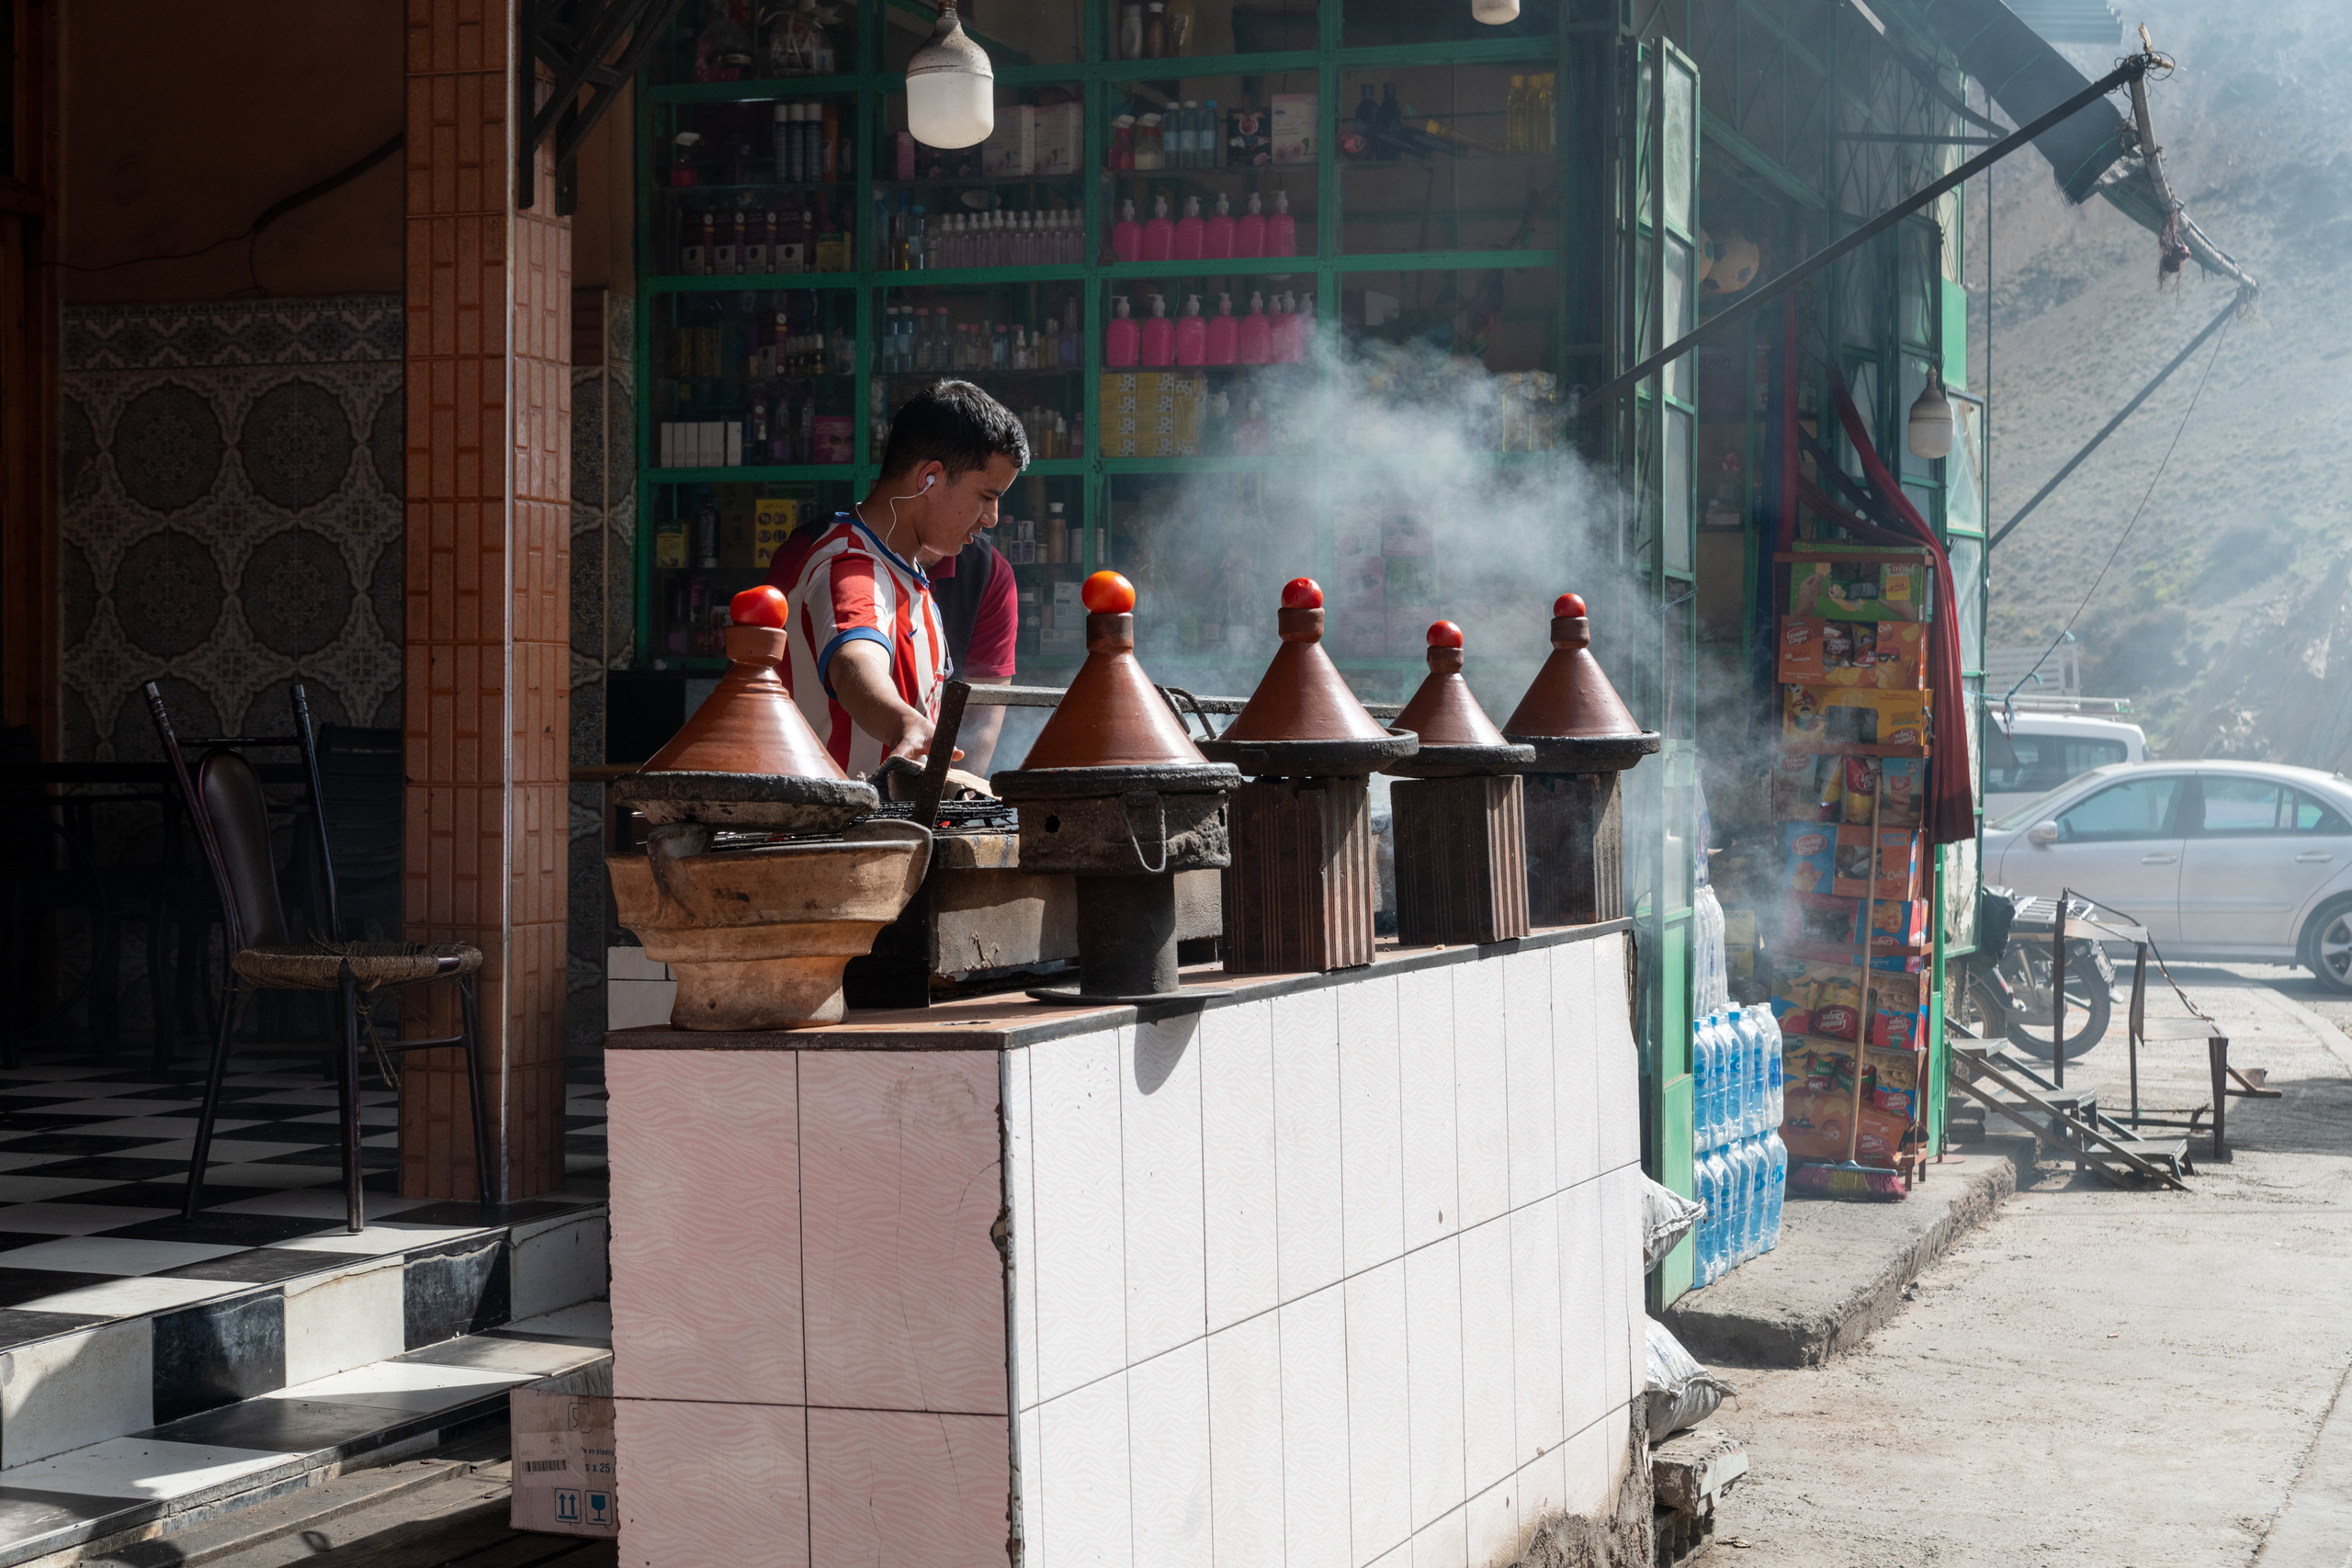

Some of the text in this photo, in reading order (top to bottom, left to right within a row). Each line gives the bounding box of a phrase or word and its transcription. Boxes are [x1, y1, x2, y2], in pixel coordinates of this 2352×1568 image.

[1878, 624, 1893, 633] Chili
[1787, 629, 1808, 639] Leader
[1789, 636, 1807, 645] Chips
[1894, 729, 1914, 739] Chips
[1796, 838, 1821, 847] Leader
[1797, 844, 1819, 853] Chips
[1887, 868, 1906, 881] Chili
[1822, 1010, 1845, 1020] Chips
[1821, 1019, 1847, 1029] Leader
[1890, 1017, 1907, 1025] Chips
[1887, 1100, 1906, 1108] Leader
[600, 1462, 610, 1473] 25
